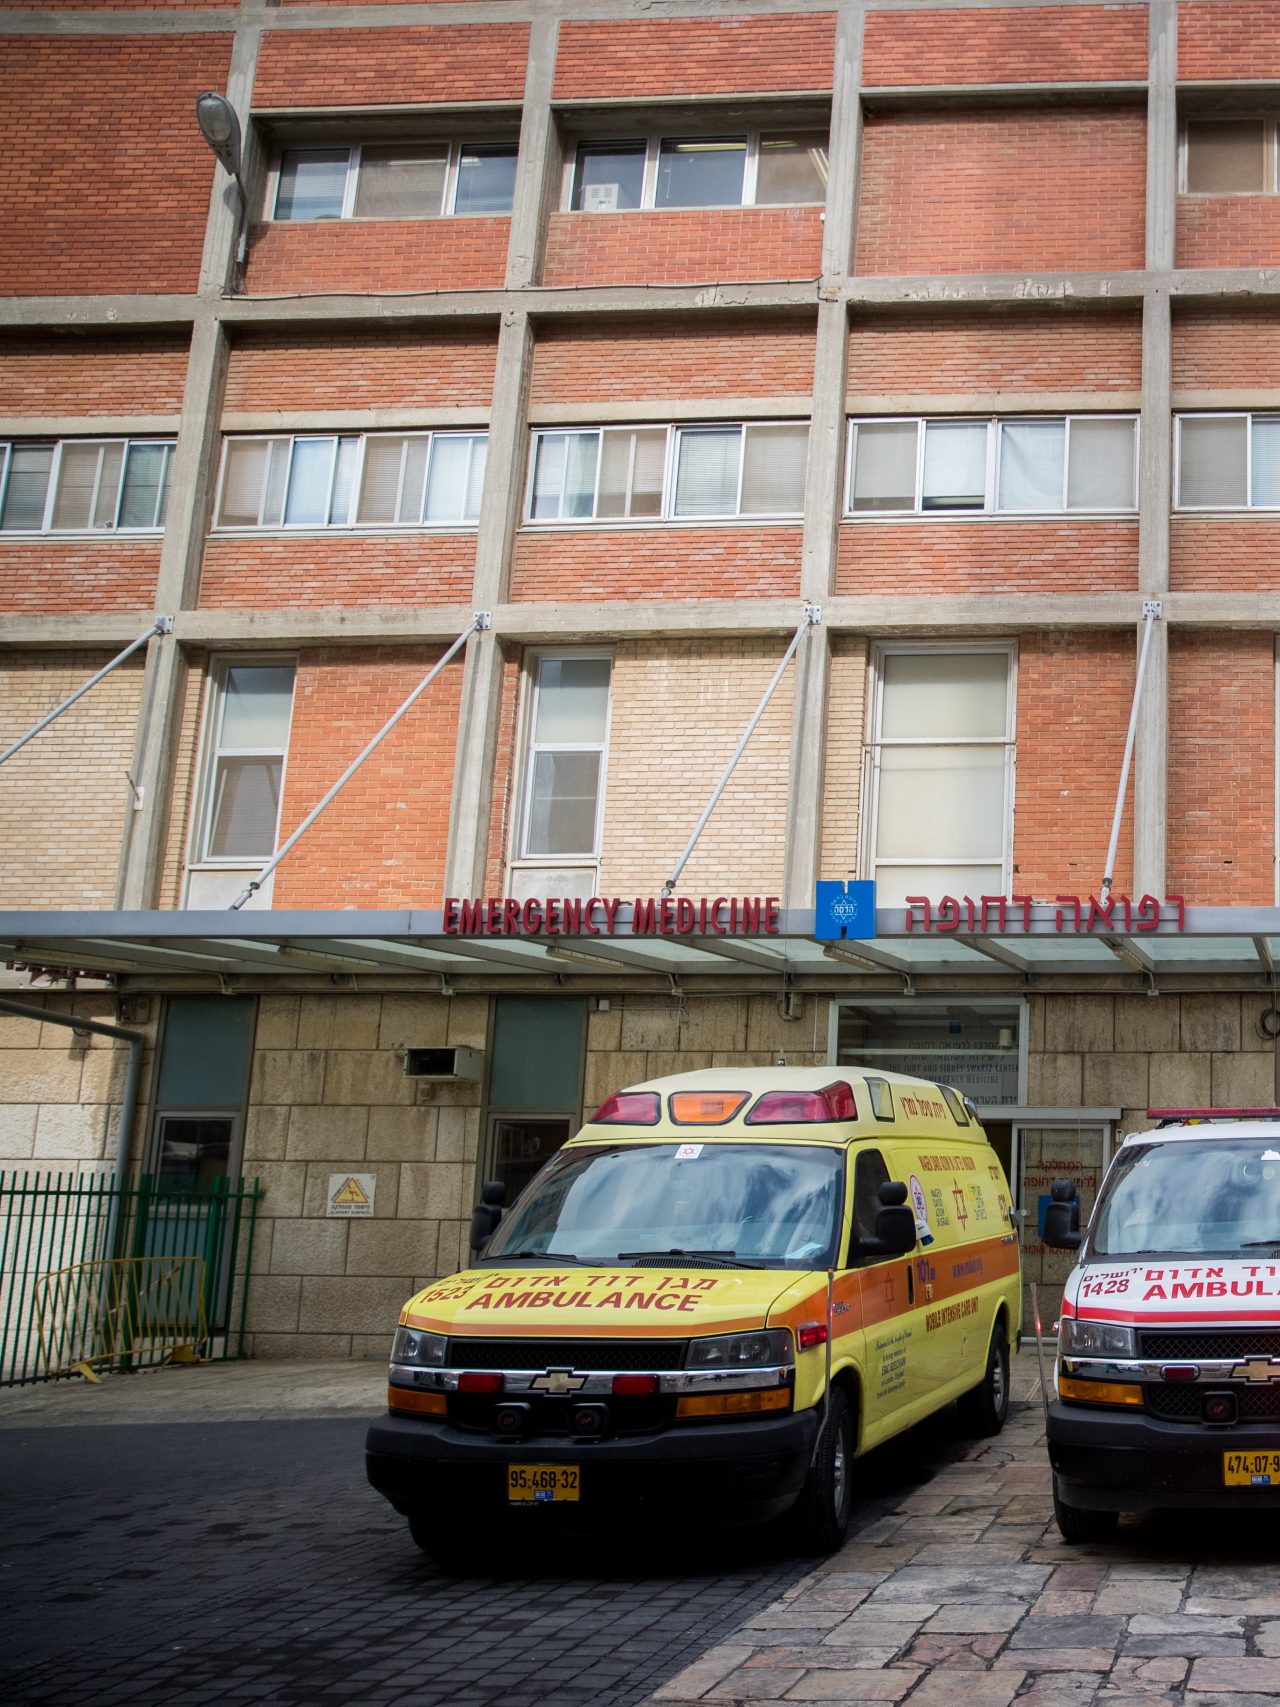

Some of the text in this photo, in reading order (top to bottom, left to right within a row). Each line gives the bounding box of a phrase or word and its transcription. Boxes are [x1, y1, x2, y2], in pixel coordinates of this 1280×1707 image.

[442, 896, 780, 934] EMERGENCY MEDICINE
[834, 906, 854, 914] הדסה
[905, 894, 1185, 932] רפואה דחופה
[924, 1064, 937, 1072] AND
[940, 1064, 964, 1072] SIDNEY
[967, 1064, 993, 1072] SWARTZ
[967, 1076, 999, 1084] MEDICINE
[1083, 1267, 1144, 1282] ירושלים
[1144, 1266, 1225, 1281] אדום
[487, 1275, 719, 1291] מגן דוד אדום
[1082, 1279, 1130, 1298] 1428
[419, 1285, 475, 1304] 1523
[464, 1291, 703, 1312] AMBULANCE
